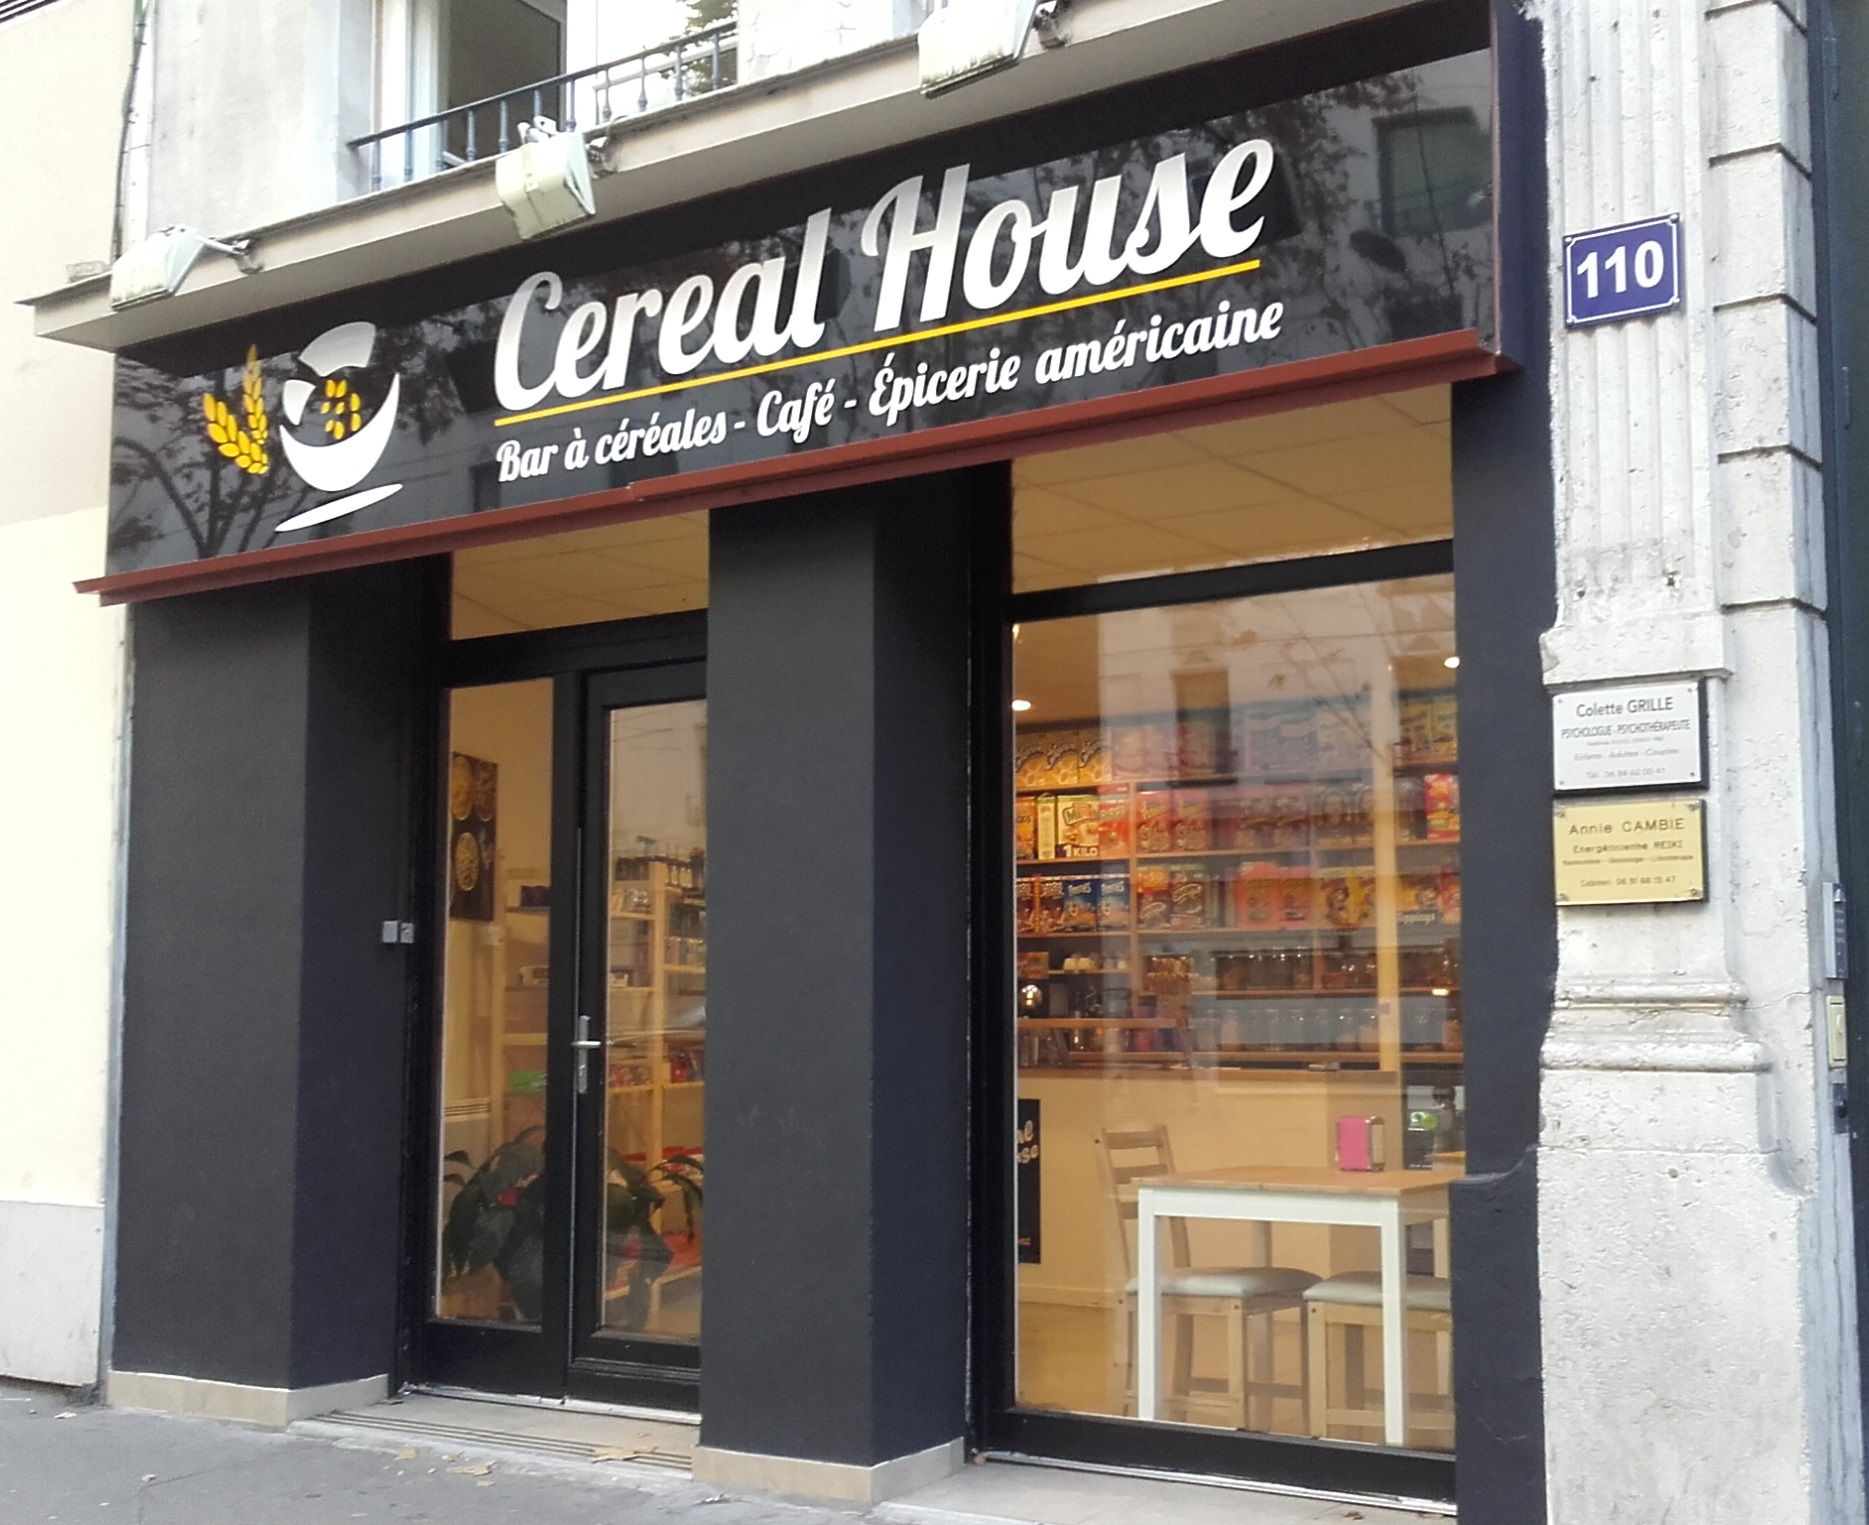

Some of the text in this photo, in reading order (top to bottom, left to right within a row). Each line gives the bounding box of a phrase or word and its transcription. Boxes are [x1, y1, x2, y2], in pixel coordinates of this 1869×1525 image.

[494, 139, 1275, 411] Cereal House
[1577, 240, 1664, 298] 110
[496, 440, 559, 481] Bar
[564, 428, 589, 469] à
[595, 408, 726, 465] céréales
[757, 378, 836, 443] Café
[868, 353, 1020, 426] Épicerie
[1035, 300, 1284, 384] américaine
[1576, 697, 1673, 717] Colette GRILLE
[1569, 818, 1685, 835] Annie CAMBIE
[1073, 847, 1098, 857] KILO
